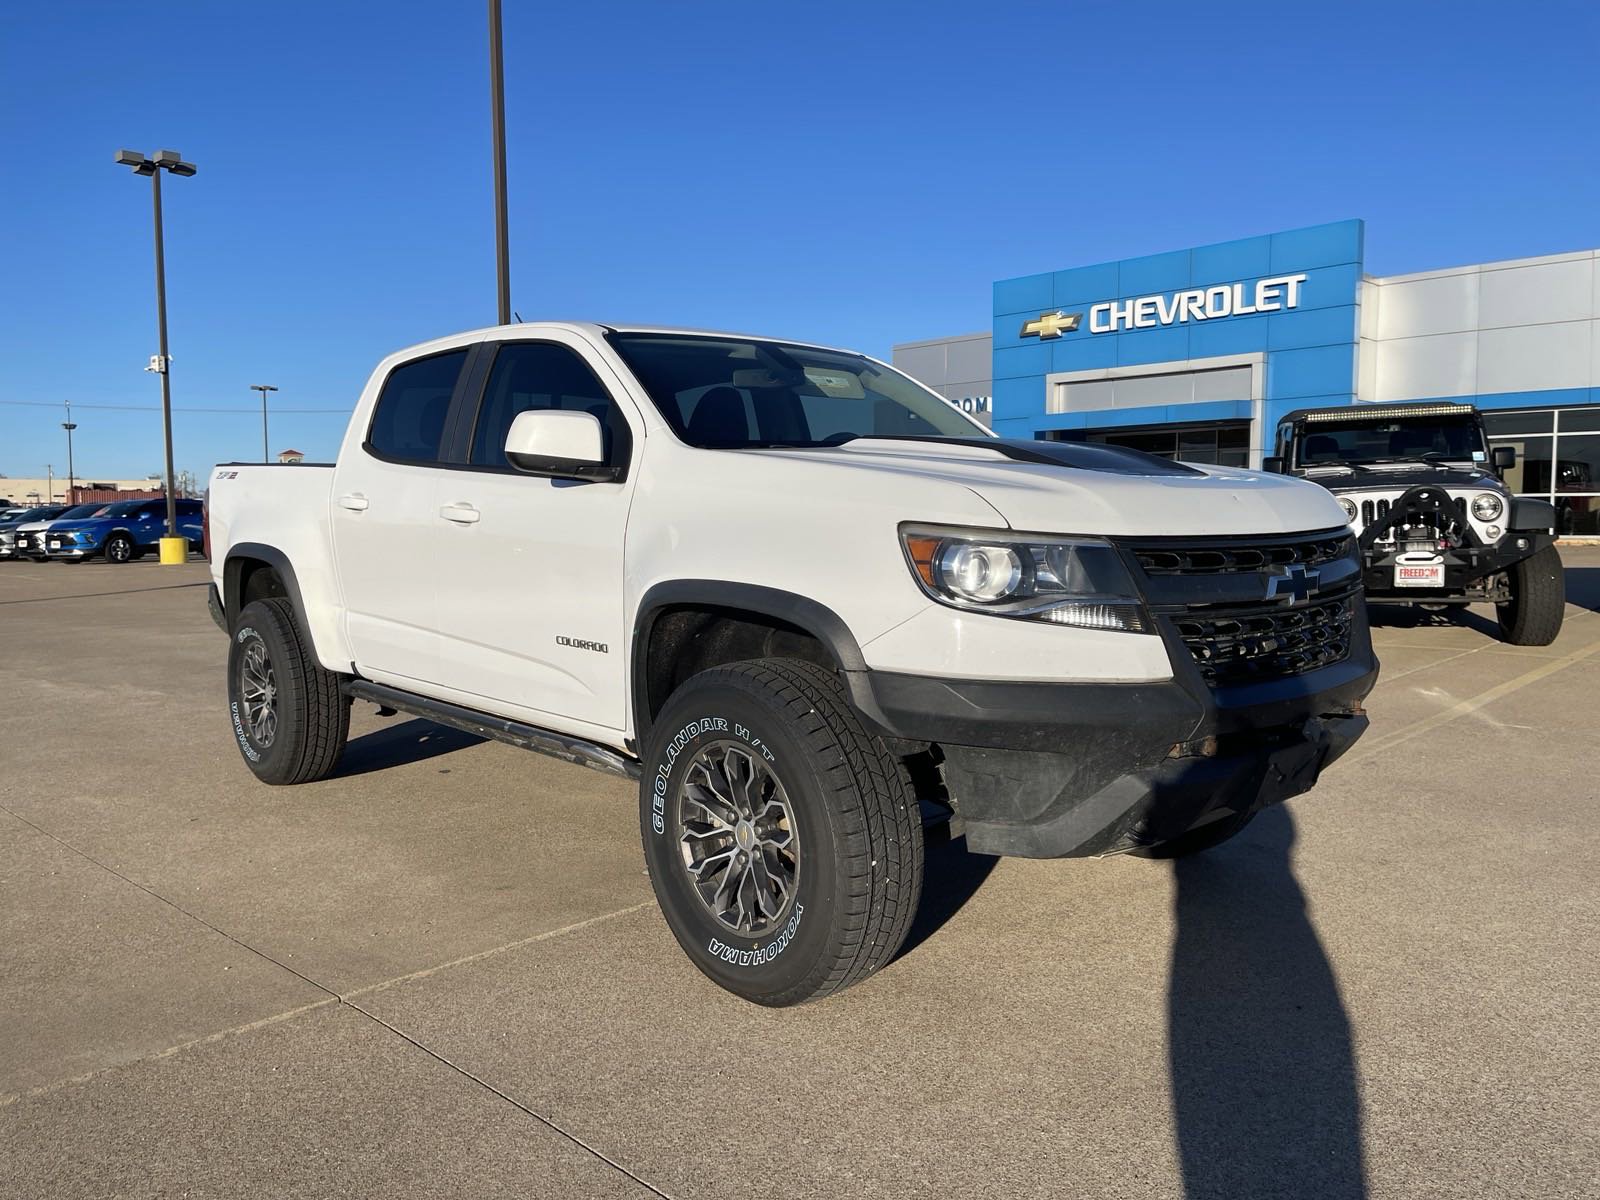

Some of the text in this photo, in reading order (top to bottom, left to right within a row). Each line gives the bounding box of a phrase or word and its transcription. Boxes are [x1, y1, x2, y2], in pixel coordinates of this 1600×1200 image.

[1089, 274, 1308, 334] CHEVROLET
[556, 635, 608, 653] COLORADO
[652, 717, 728, 834] GEOLANDAR
[708, 902, 804, 966] YOKOHAMA
